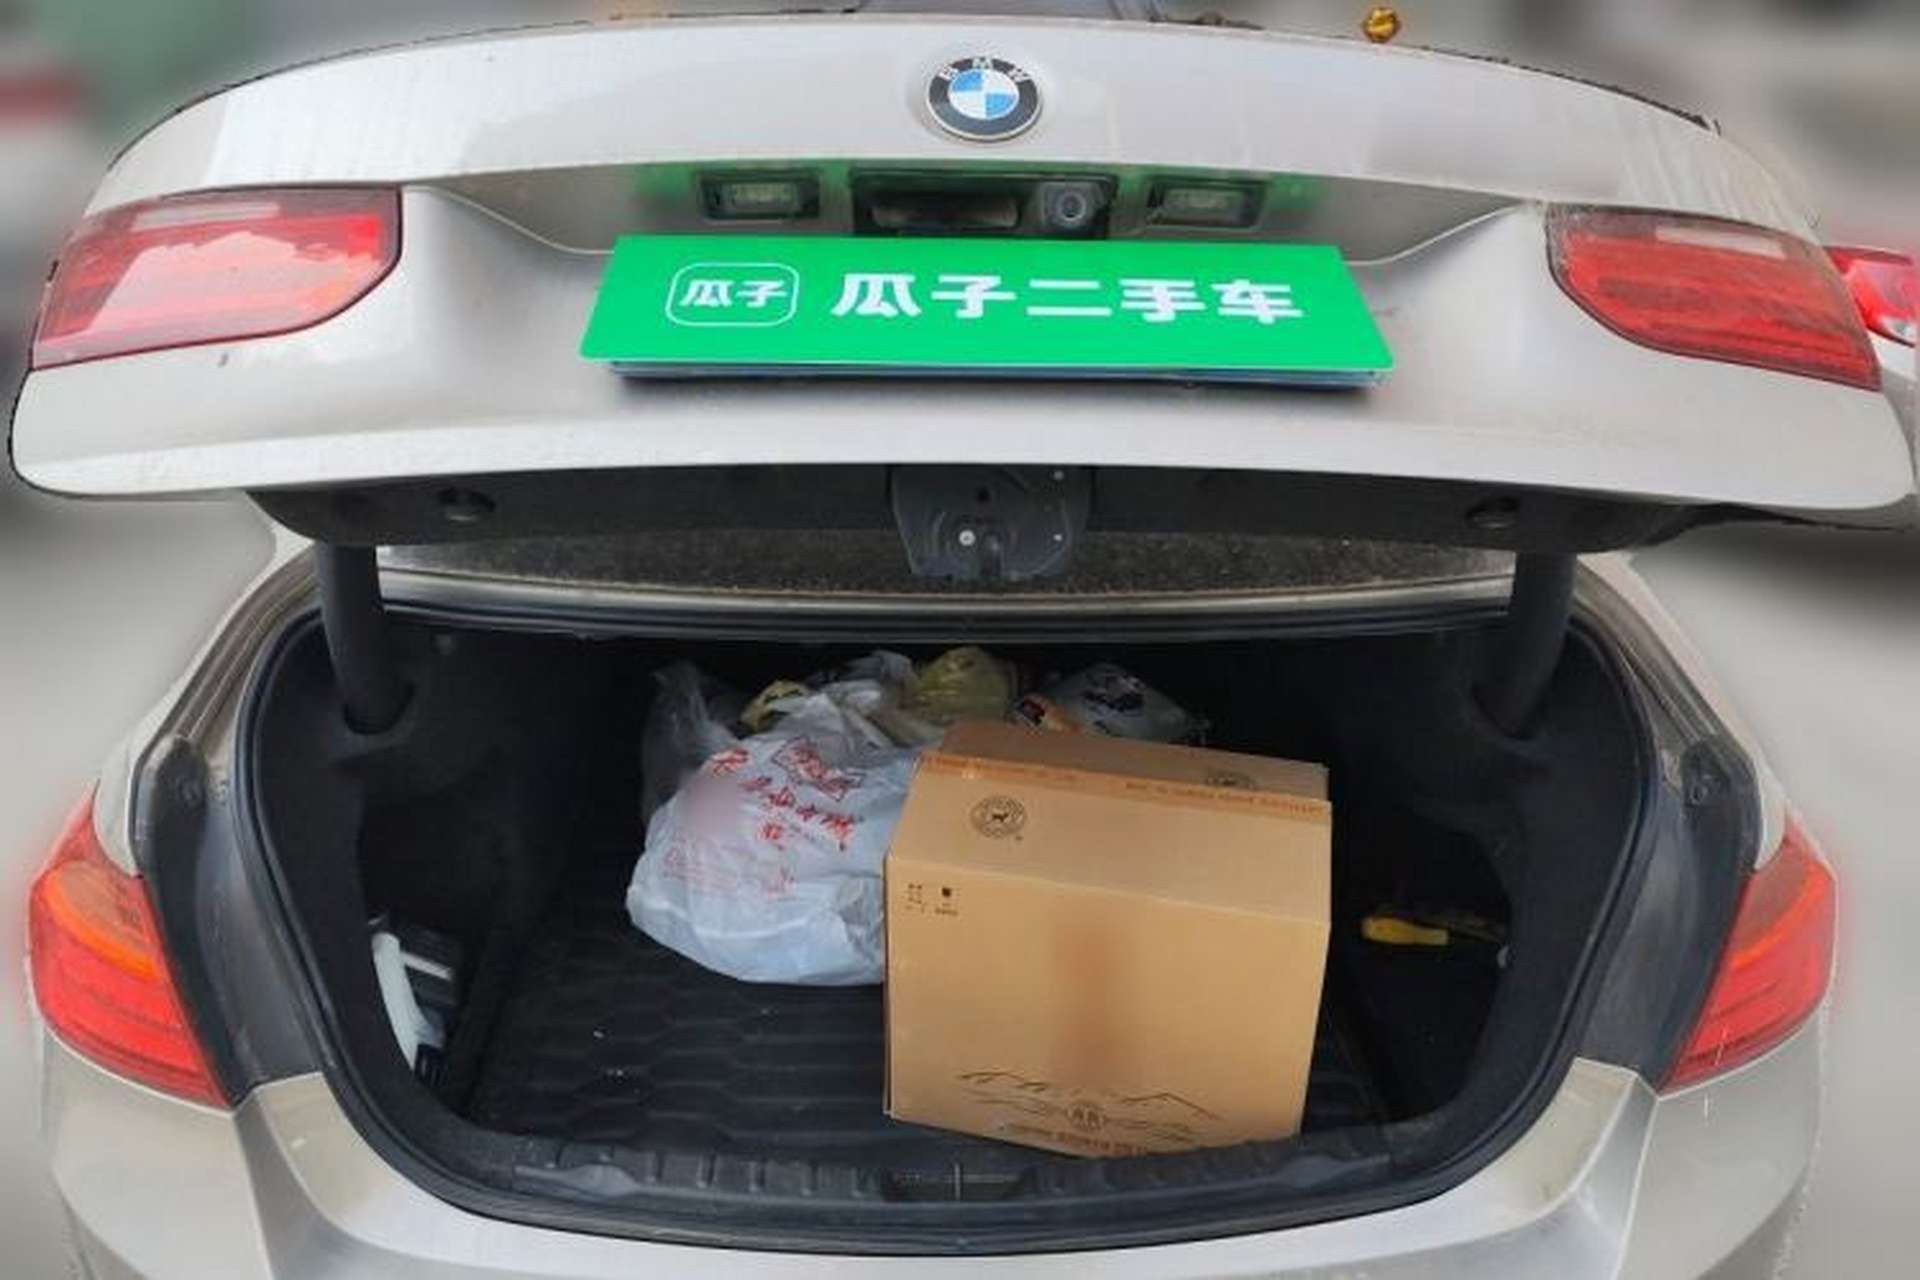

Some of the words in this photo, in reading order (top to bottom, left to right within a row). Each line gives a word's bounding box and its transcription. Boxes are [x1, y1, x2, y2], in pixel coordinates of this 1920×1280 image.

[679, 279, 788, 308] 瓜子
[830, 273, 1304, 324] 瓜子二手车
